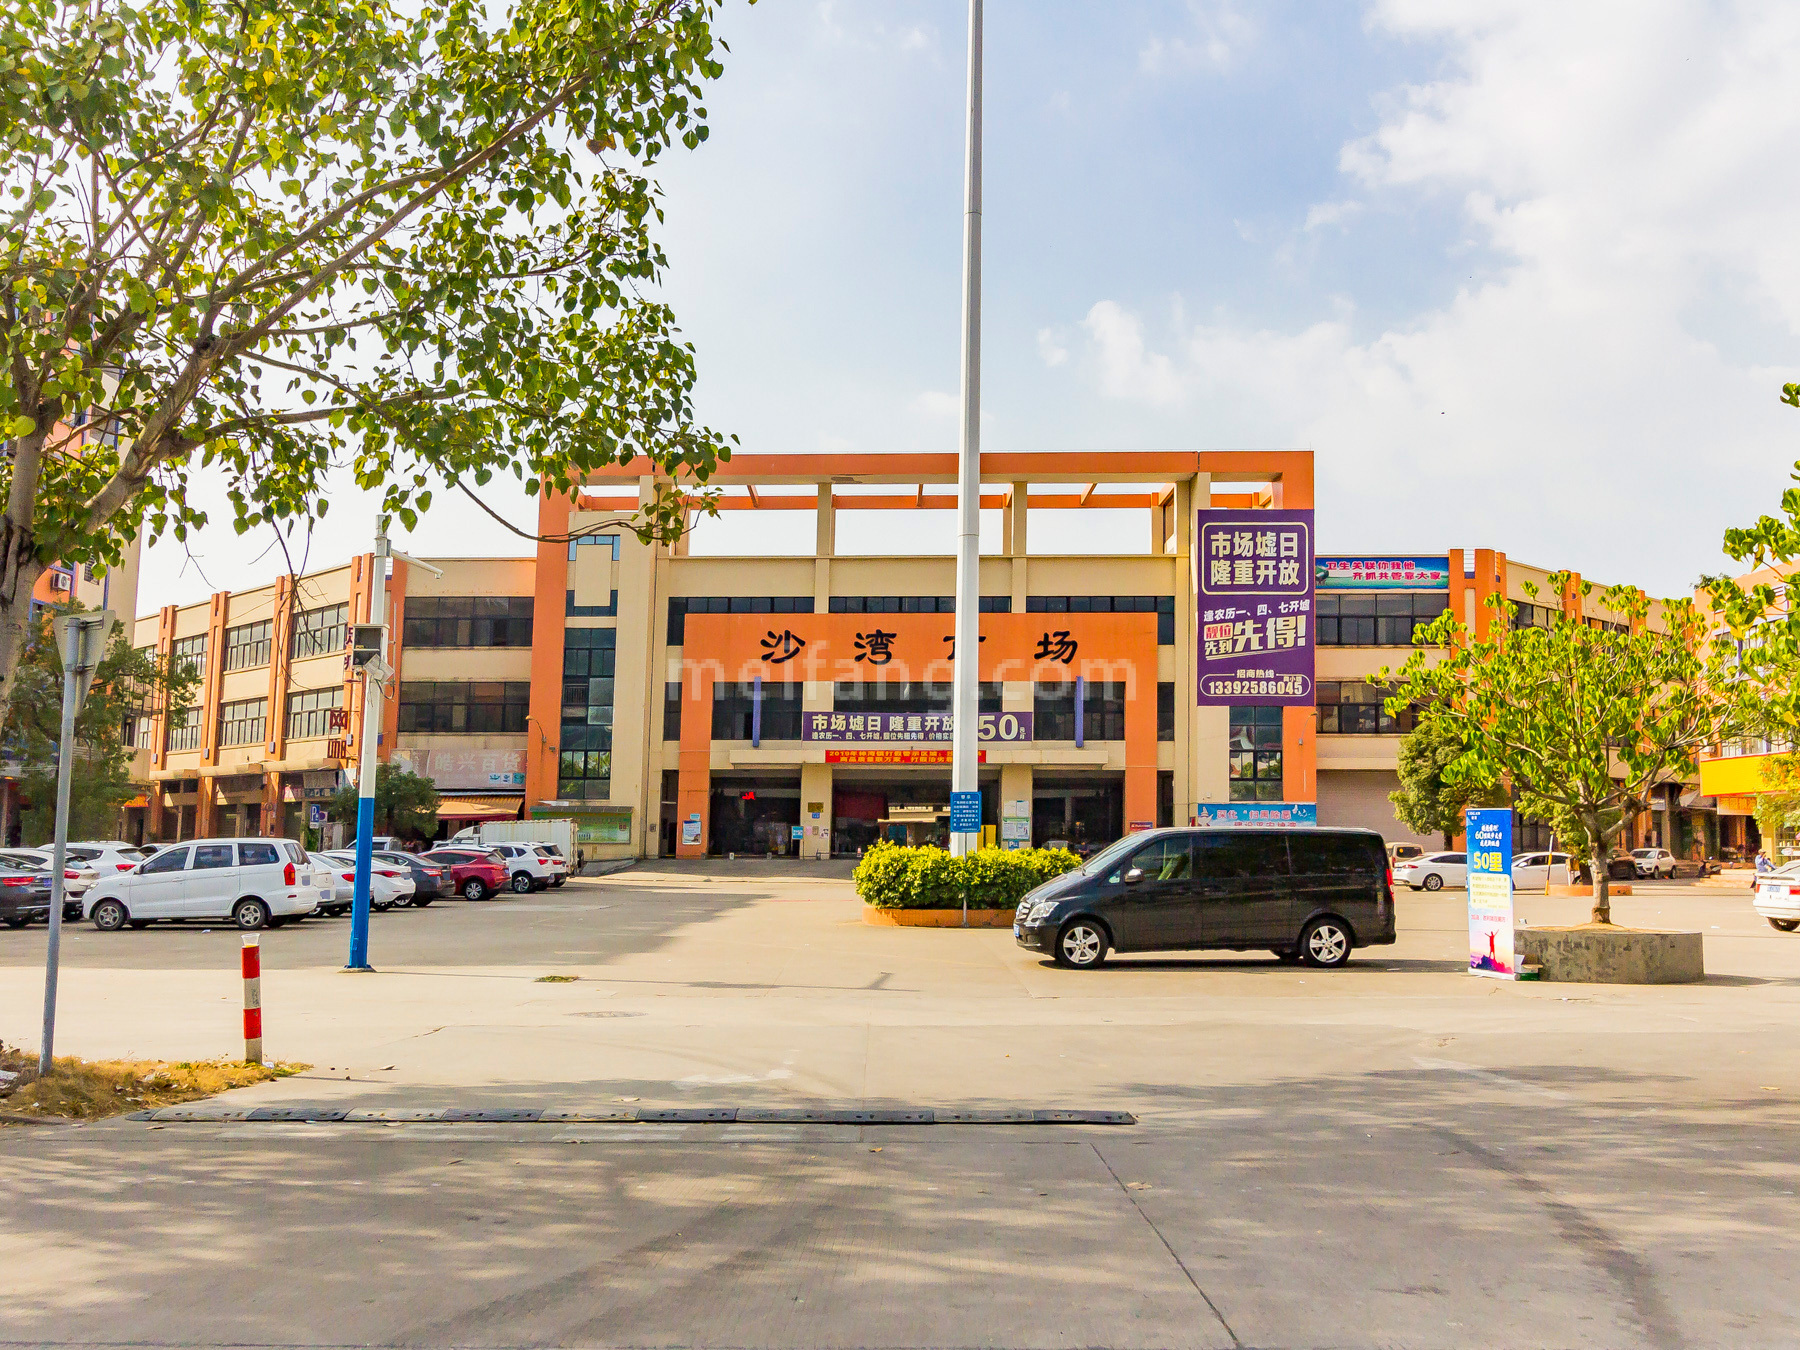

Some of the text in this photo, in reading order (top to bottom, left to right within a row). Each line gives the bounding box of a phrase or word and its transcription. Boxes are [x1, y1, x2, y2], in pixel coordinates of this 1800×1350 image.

[1210, 531, 1298, 558] 市场墟日
[1210, 559, 1300, 586] 隆重开放
[1326, 561, 1416, 571] 卫生关联你我他
[1208, 681, 1303, 695] 13392586045
[812, 714, 954, 732] 市场墟日 隆重开放
[1473, 851, 1503, 872] 50里
